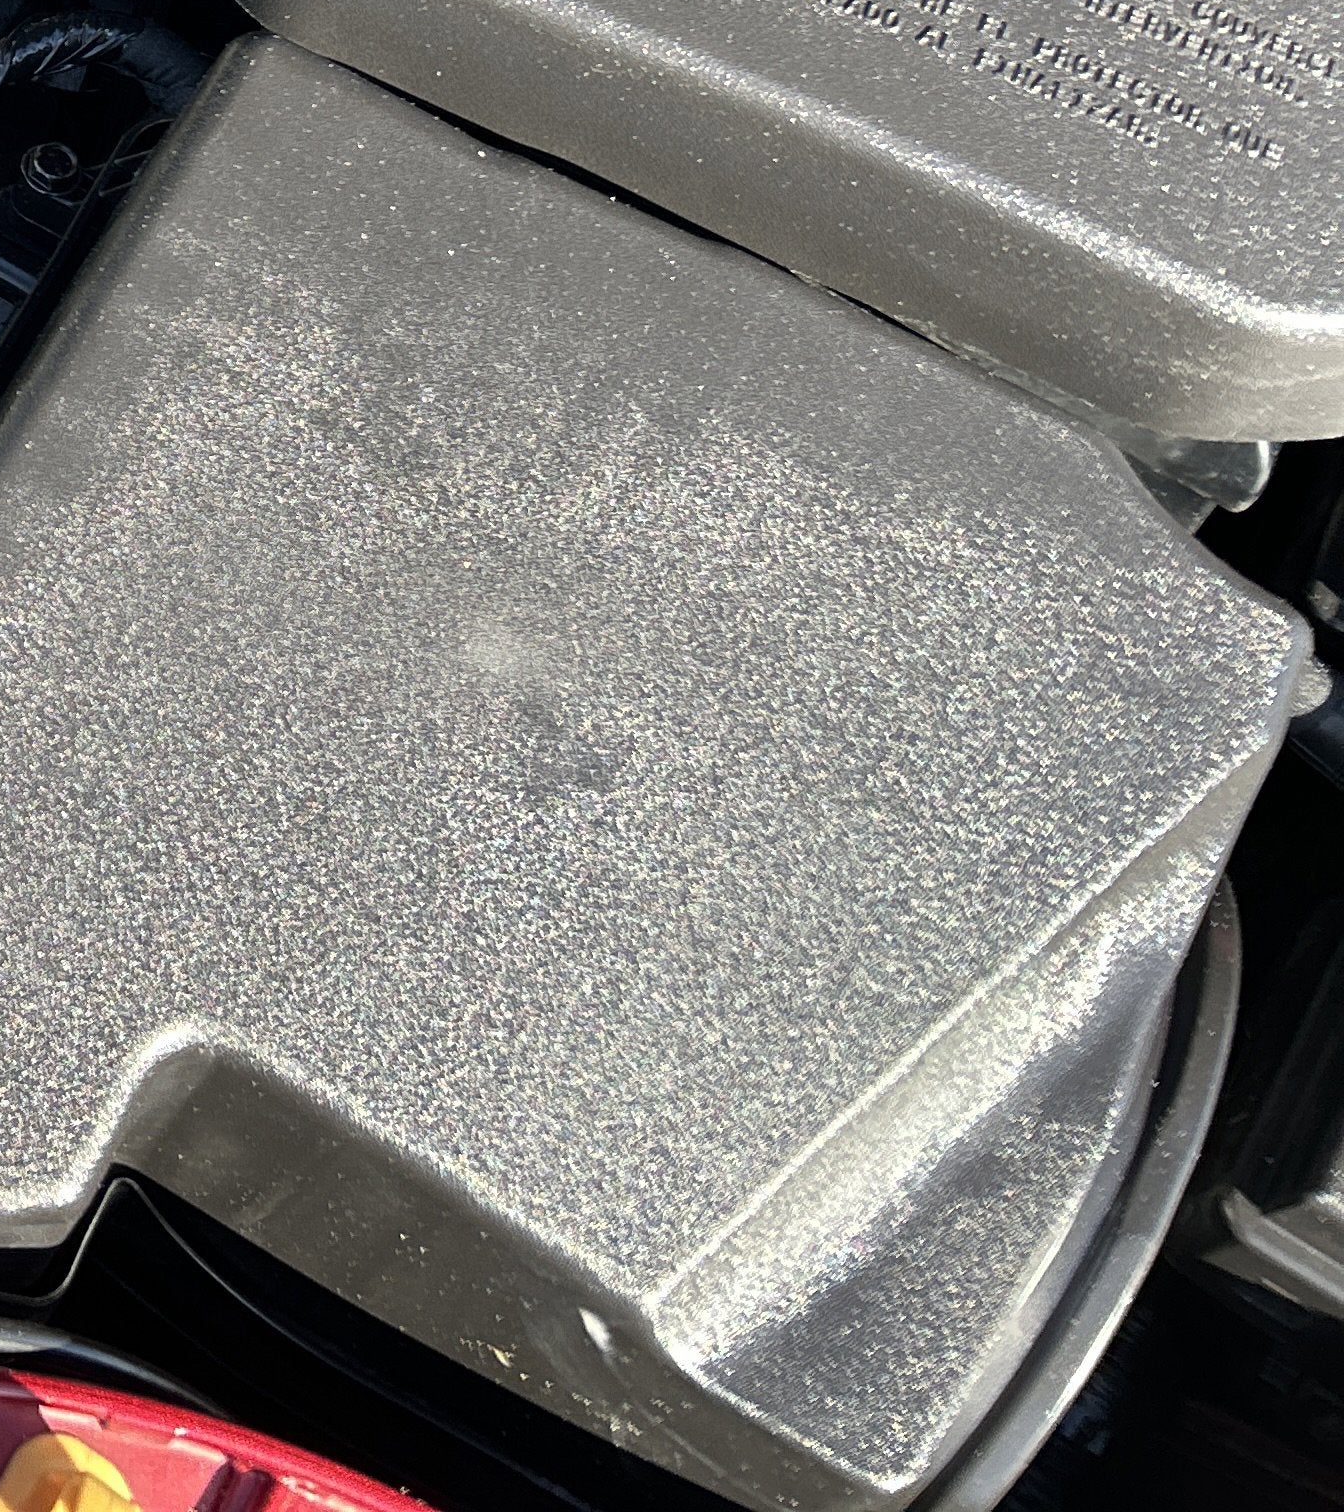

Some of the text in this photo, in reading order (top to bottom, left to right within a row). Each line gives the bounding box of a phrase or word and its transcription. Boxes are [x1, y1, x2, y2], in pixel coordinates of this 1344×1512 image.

[913, 21, 956, 56] AL
[976, 12, 1010, 41] EL
[1028, 35, 1211, 129] PROTECTOR
[1216, 119, 1291, 171] QUE
